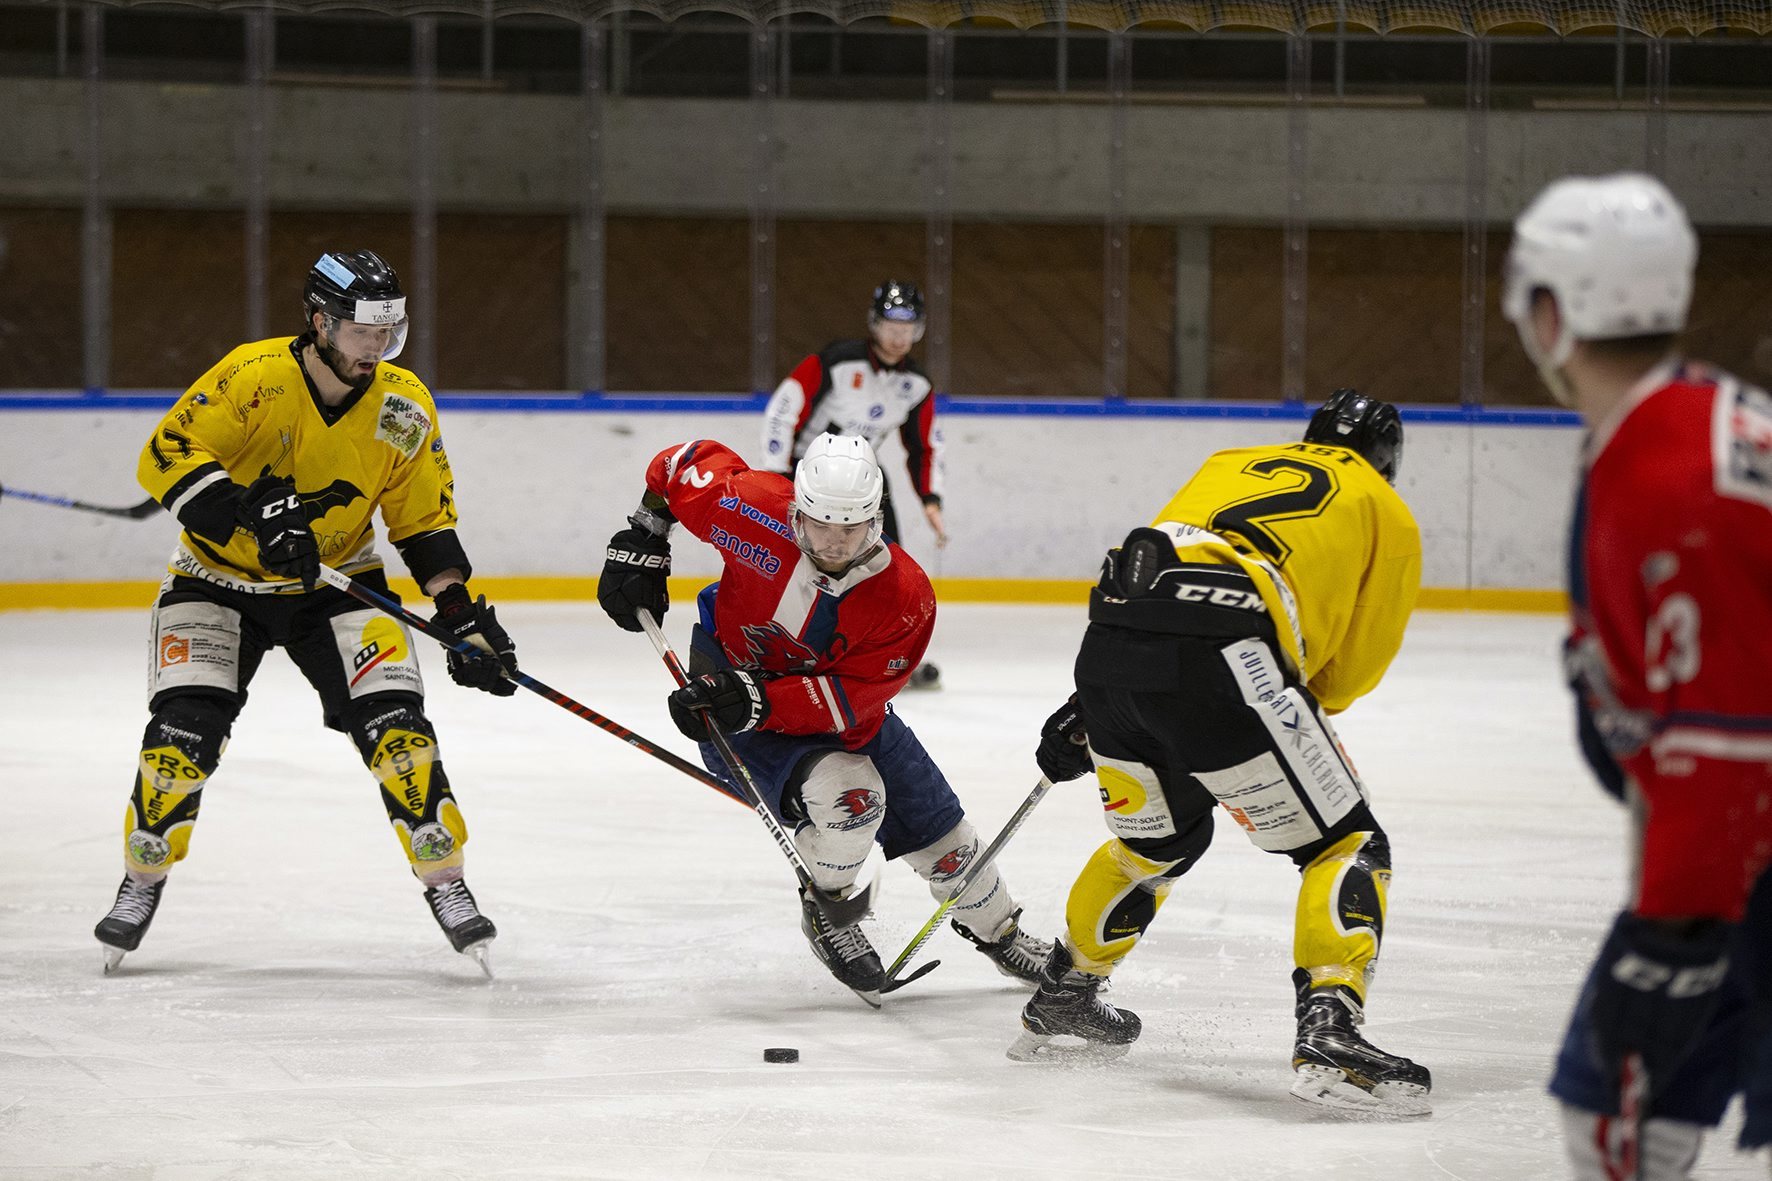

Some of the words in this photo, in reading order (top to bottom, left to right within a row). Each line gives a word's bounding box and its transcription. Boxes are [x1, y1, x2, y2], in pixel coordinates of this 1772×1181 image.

[680, 464, 715, 489] 2
[1205, 454, 1341, 570] 2
[607, 547, 672, 569] BAUER
[709, 523, 782, 575] zanotta
[1174, 583, 1268, 614] CCM
[453, 619, 476, 636] CCM
[734, 669, 763, 735] BAUE
[1113, 814, 1170, 826] MONT-SOLEIL
[1115, 822, 1166, 833] SAINT-IMIER
